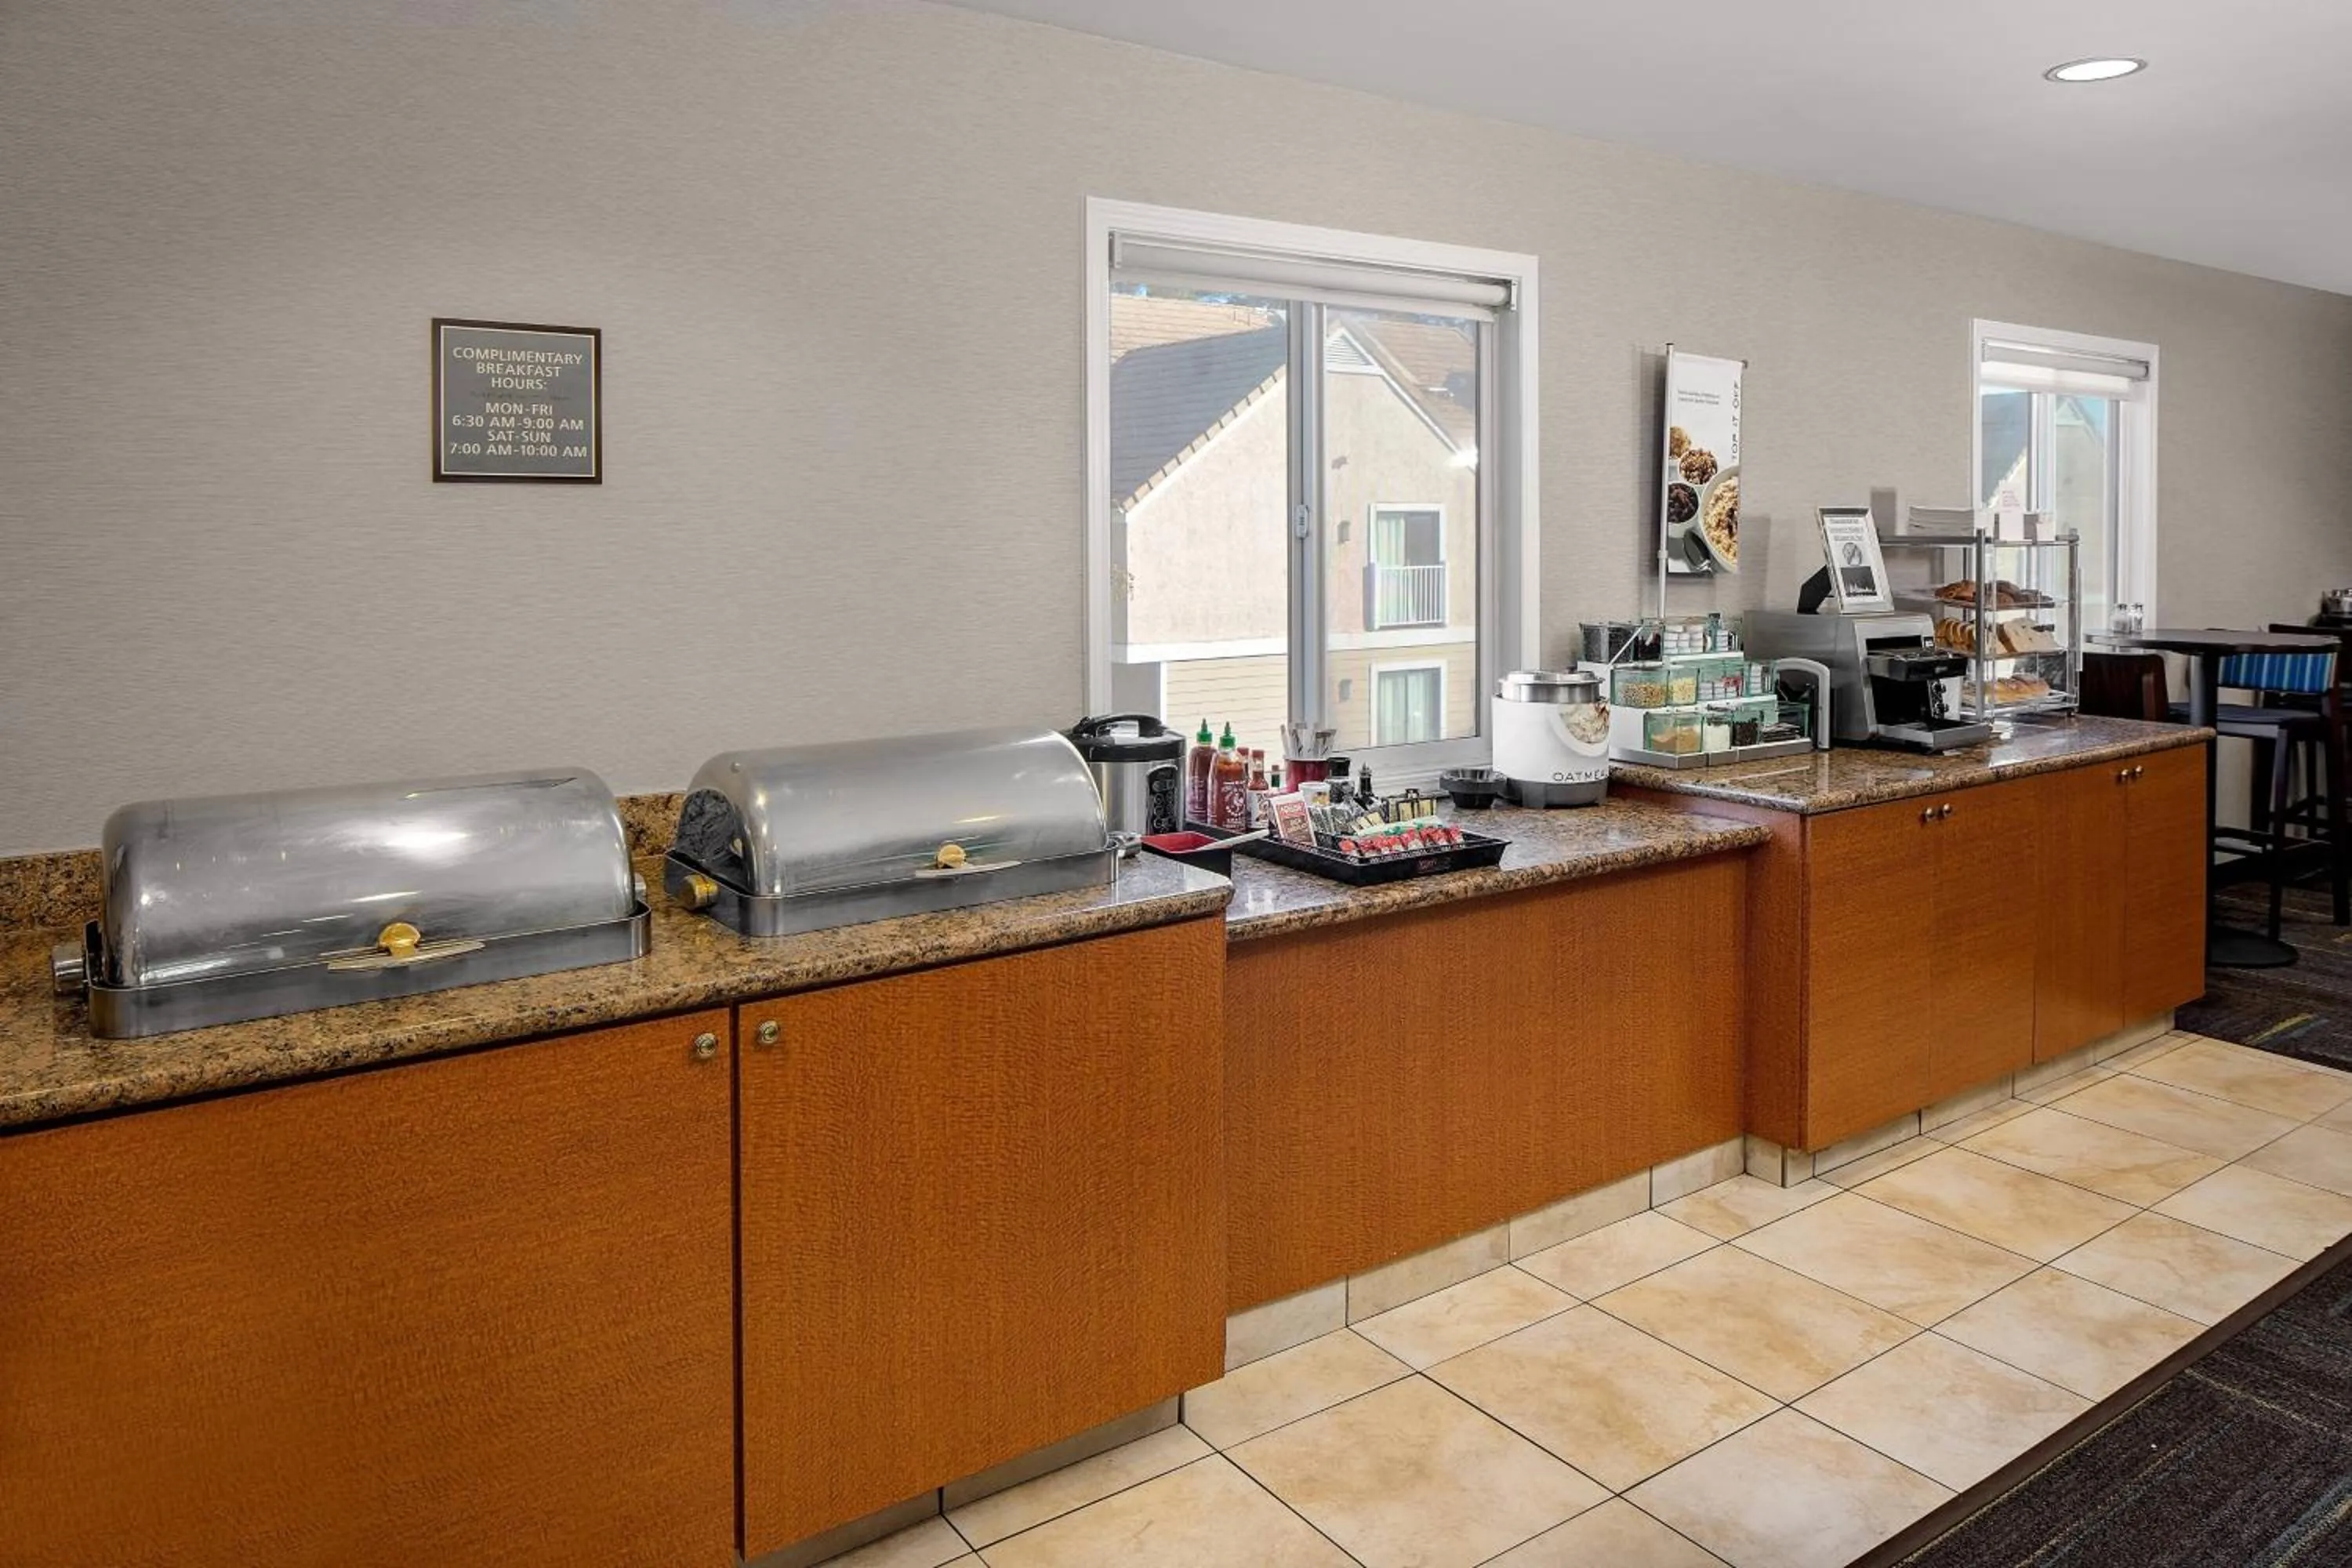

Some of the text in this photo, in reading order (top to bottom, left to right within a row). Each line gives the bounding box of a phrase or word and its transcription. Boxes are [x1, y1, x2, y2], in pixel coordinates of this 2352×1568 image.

[452, 347, 583, 365] COMPLIMENTARY
[476, 362, 561, 377] BREAKFAST
[492, 377, 547, 390] HOURS:
[485, 402, 553, 415] MON-FRI
[452, 416, 484, 427] 6:30
[559, 419, 584, 430] AM
[488, 430, 552, 443] SAT-SUN
[450, 441, 481, 454] 7:00
[562, 446, 587, 457] AM
